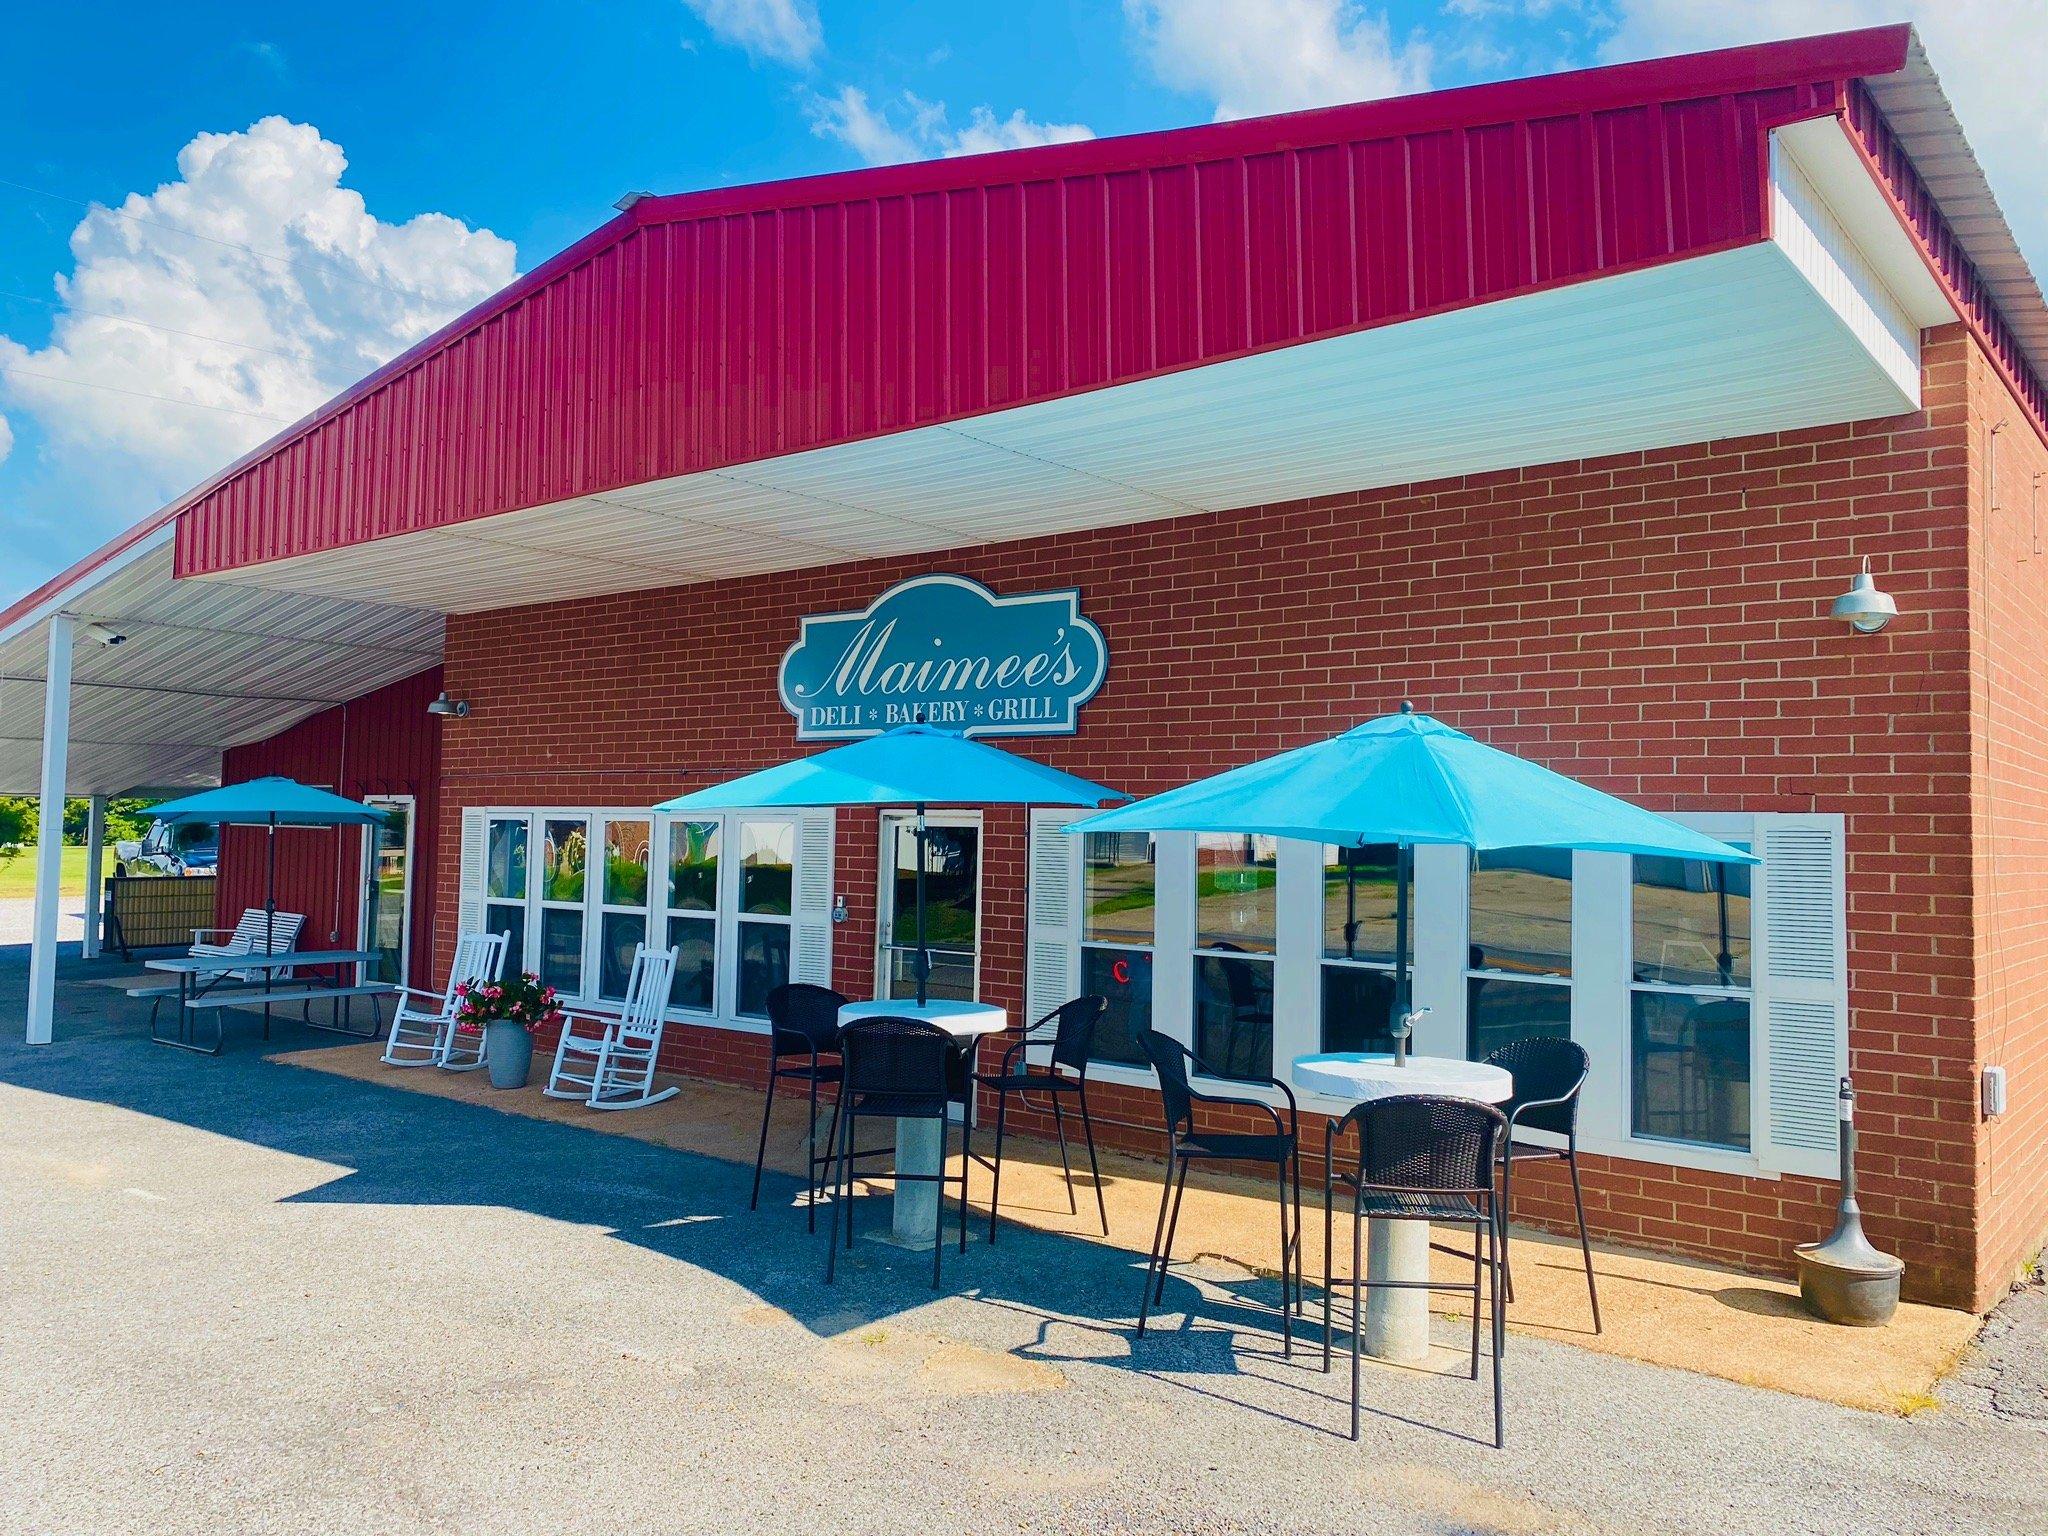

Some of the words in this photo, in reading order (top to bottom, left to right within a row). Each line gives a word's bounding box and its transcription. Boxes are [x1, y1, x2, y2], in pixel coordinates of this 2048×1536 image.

[794, 617, 1082, 697] Maimee's
[810, 704, 861, 726] DELI
[885, 700, 970, 725] BAKERY
[988, 697, 1058, 720] GRILL
